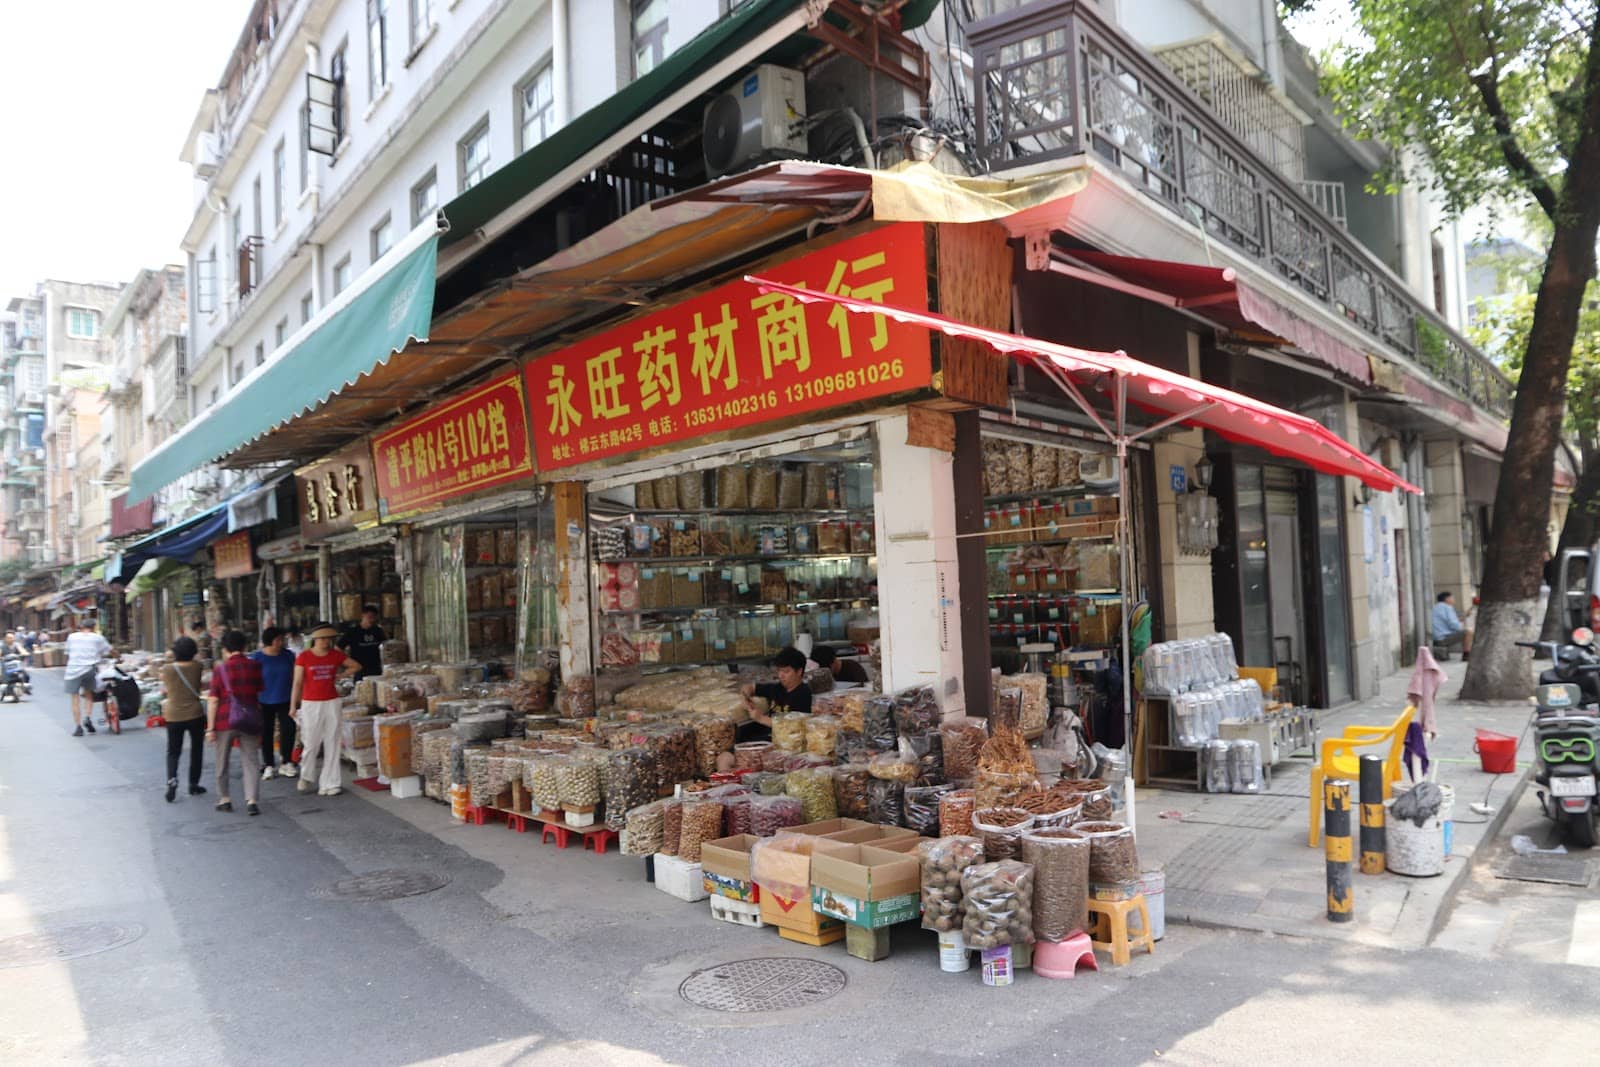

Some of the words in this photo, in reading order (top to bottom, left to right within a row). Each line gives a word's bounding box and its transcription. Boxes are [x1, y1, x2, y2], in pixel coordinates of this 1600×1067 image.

[546, 252, 895, 437] 永旺药材商行
[785, 359, 904, 402] 13109681026
